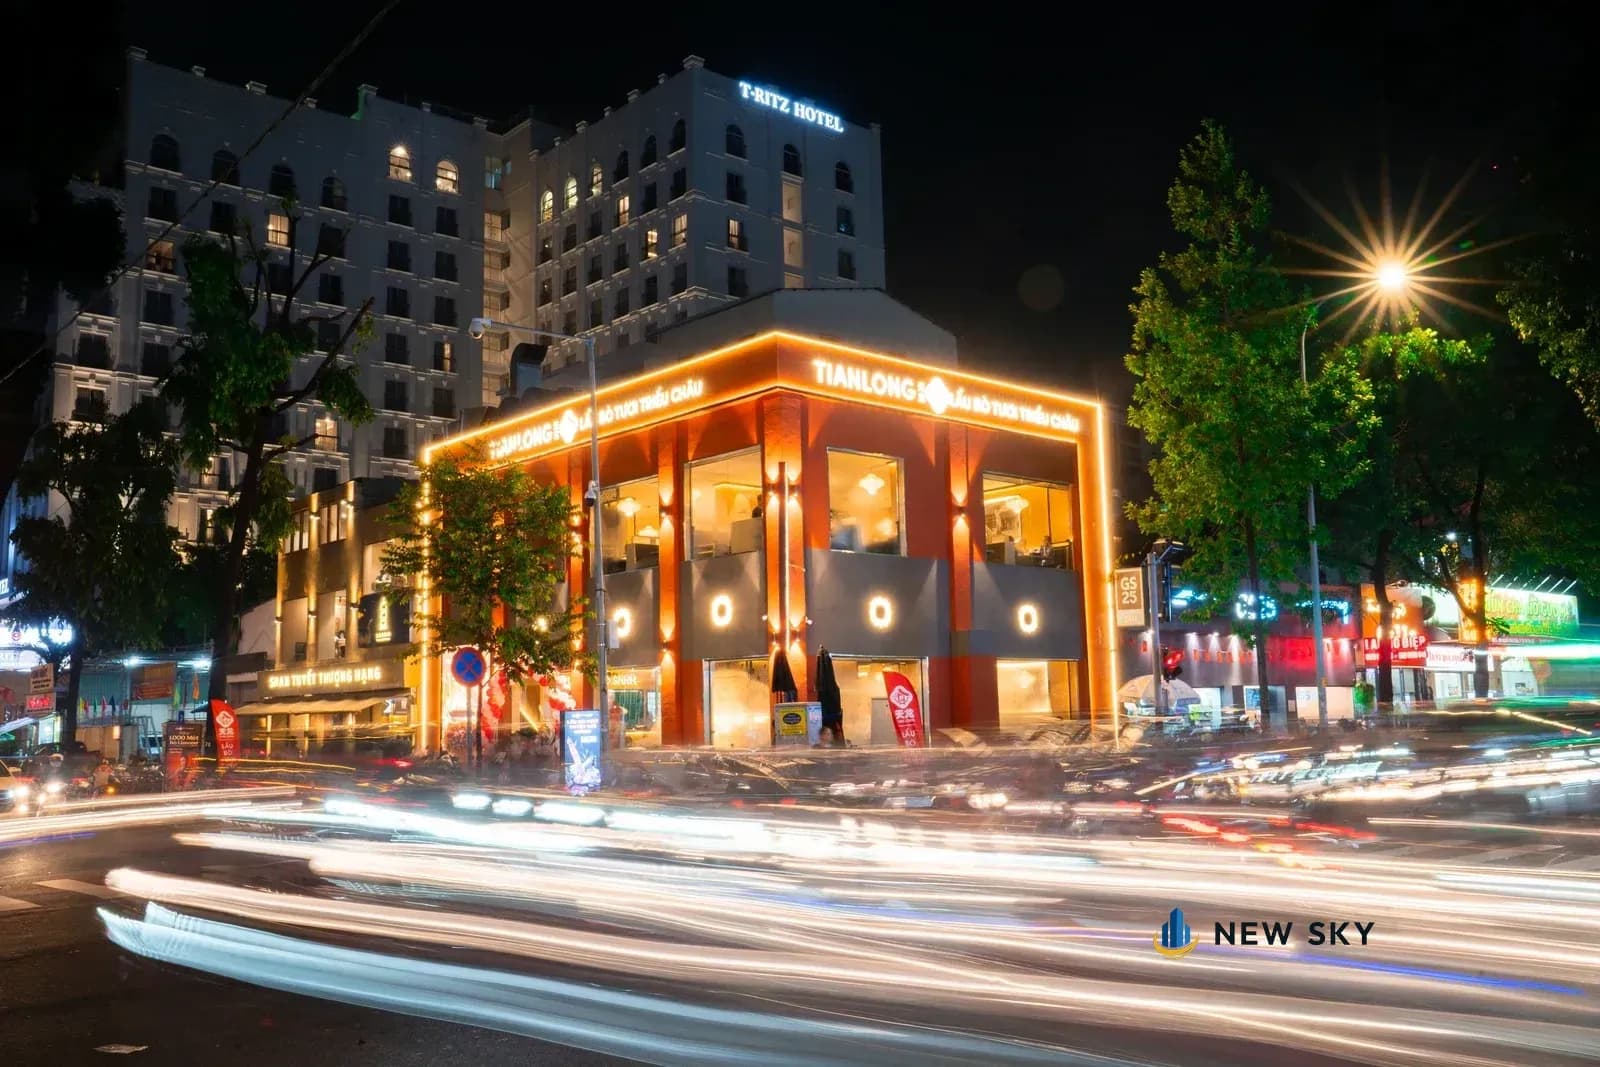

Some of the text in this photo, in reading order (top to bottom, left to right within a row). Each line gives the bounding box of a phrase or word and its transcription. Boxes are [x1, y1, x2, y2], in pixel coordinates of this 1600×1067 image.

[739, 81, 844, 132] T-RITZ HOTEL
[812, 358, 916, 401] TIANLONG
[1120, 576, 1137, 591] GS
[1122, 590, 1137, 604] 25
